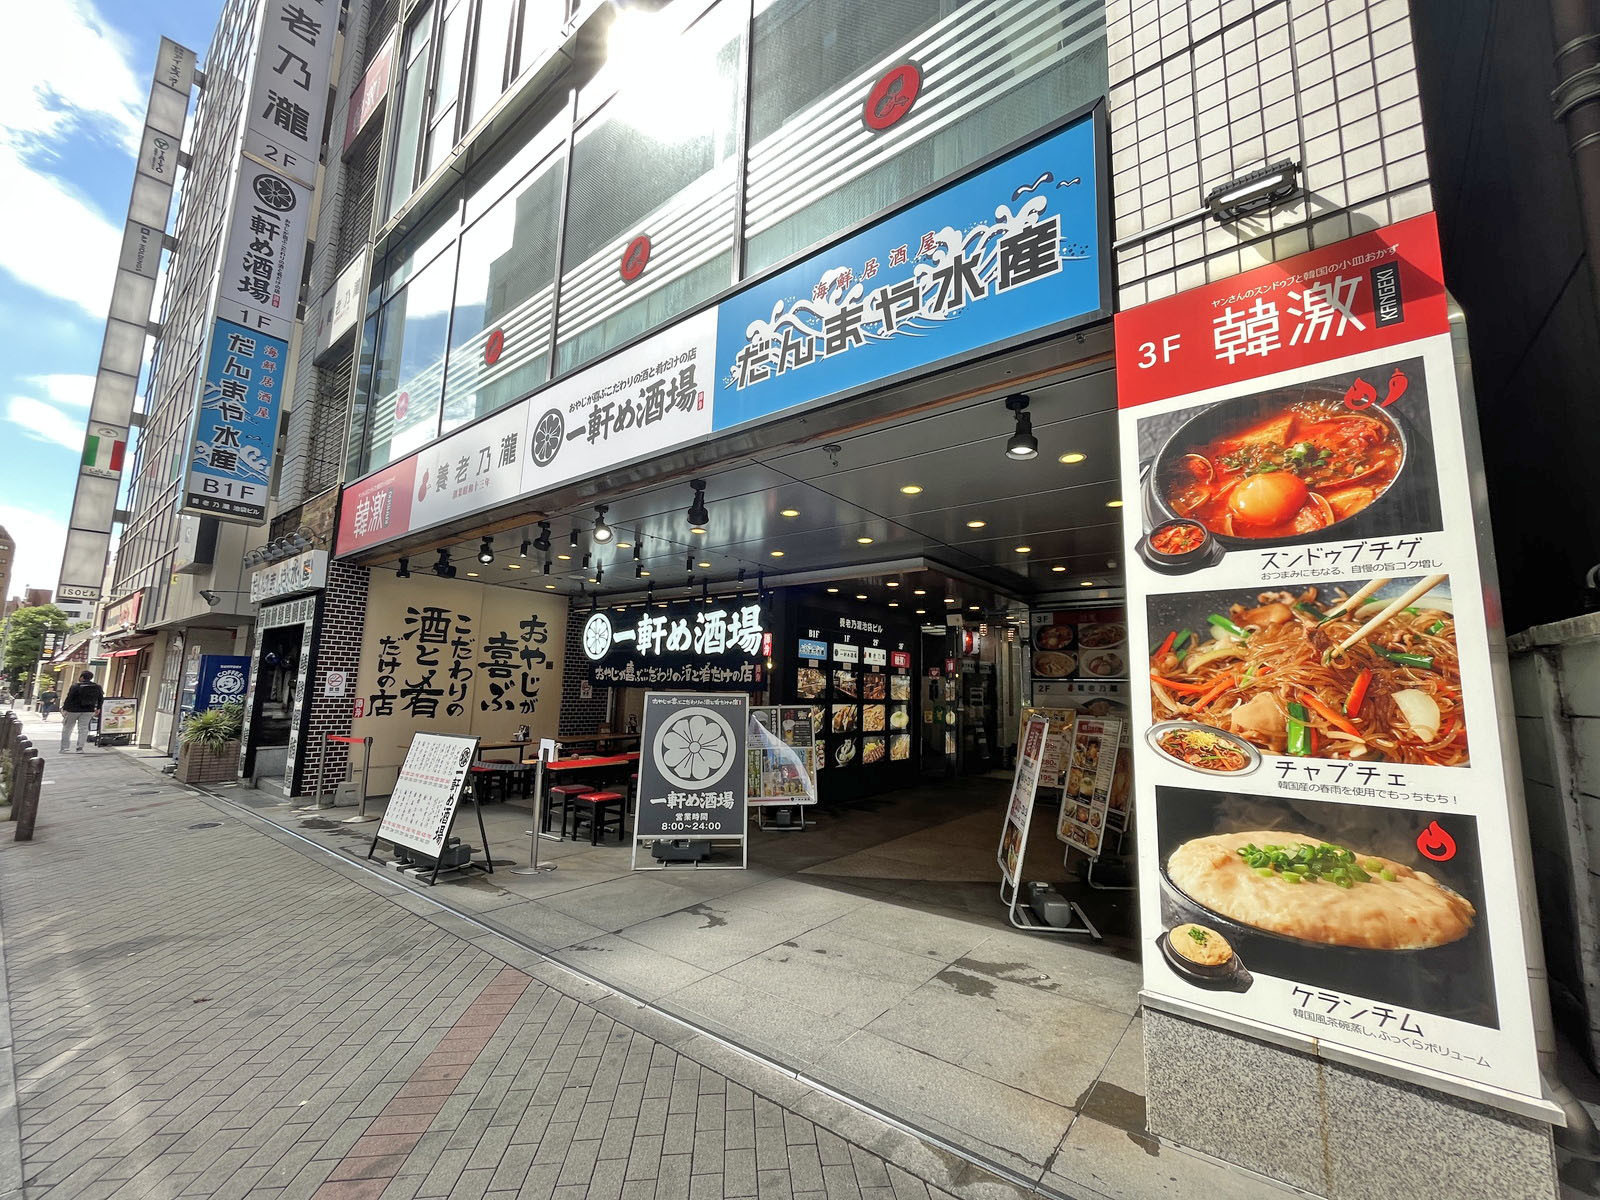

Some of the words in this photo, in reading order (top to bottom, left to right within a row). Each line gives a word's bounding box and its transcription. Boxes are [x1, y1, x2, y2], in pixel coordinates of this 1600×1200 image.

[262, 0, 326, 142] 老乃瀧
[264, 144, 297, 168] 2F
[237, 205, 281, 305] 一軒め酒場
[812, 231, 938, 301] 海鮮居酒屋
[1211, 243, 1400, 307] ヤンさんのスンドゥブと韓国の小皿おかず
[240, 310, 272, 328] 1F
[736, 214, 1063, 392] だんまや水産
[1211, 274, 1367, 365] 韓激
[1381, 268, 1398, 322] KANGEKI
[1137, 333, 1182, 369] 3F
[208, 332, 256, 473] だんまや水産
[254, 344, 280, 420] 海鮮居酒屋
[566, 363, 698, 445] 一軒め酒場
[568, 347, 697, 413] おやじが喜ぶこだわりの酒と肴だけの店
[203, 478, 256, 500] B1F
[435, 432, 518, 492] 養老乃瀧
[353, 490, 387, 539] 韓激
[1260, 537, 1423, 570] スンドゥブチゲ
[1260, 559, 1443, 581] おつまみにもなる、自慢の旨コク増し
[612, 604, 764, 657] 一軒め酒場
[808, 629, 820, 638] B1F
[217, 669, 244, 679] COFFEE
[366, 635, 405, 717] だけの店
[401, 606, 453, 719] 酒と肴
[446, 614, 475, 717] こだわりの
[478, 631, 523, 711] 喜ぶ
[519, 614, 549, 714] おやじが
[209, 694, 244, 704] BOSS
[650, 791, 735, 810] 一軒め酒場
[1275, 761, 1406, 787] チャプチェ
[675, 812, 709, 821] 営業時間
[1292, 985, 1425, 1037] ケランチム
